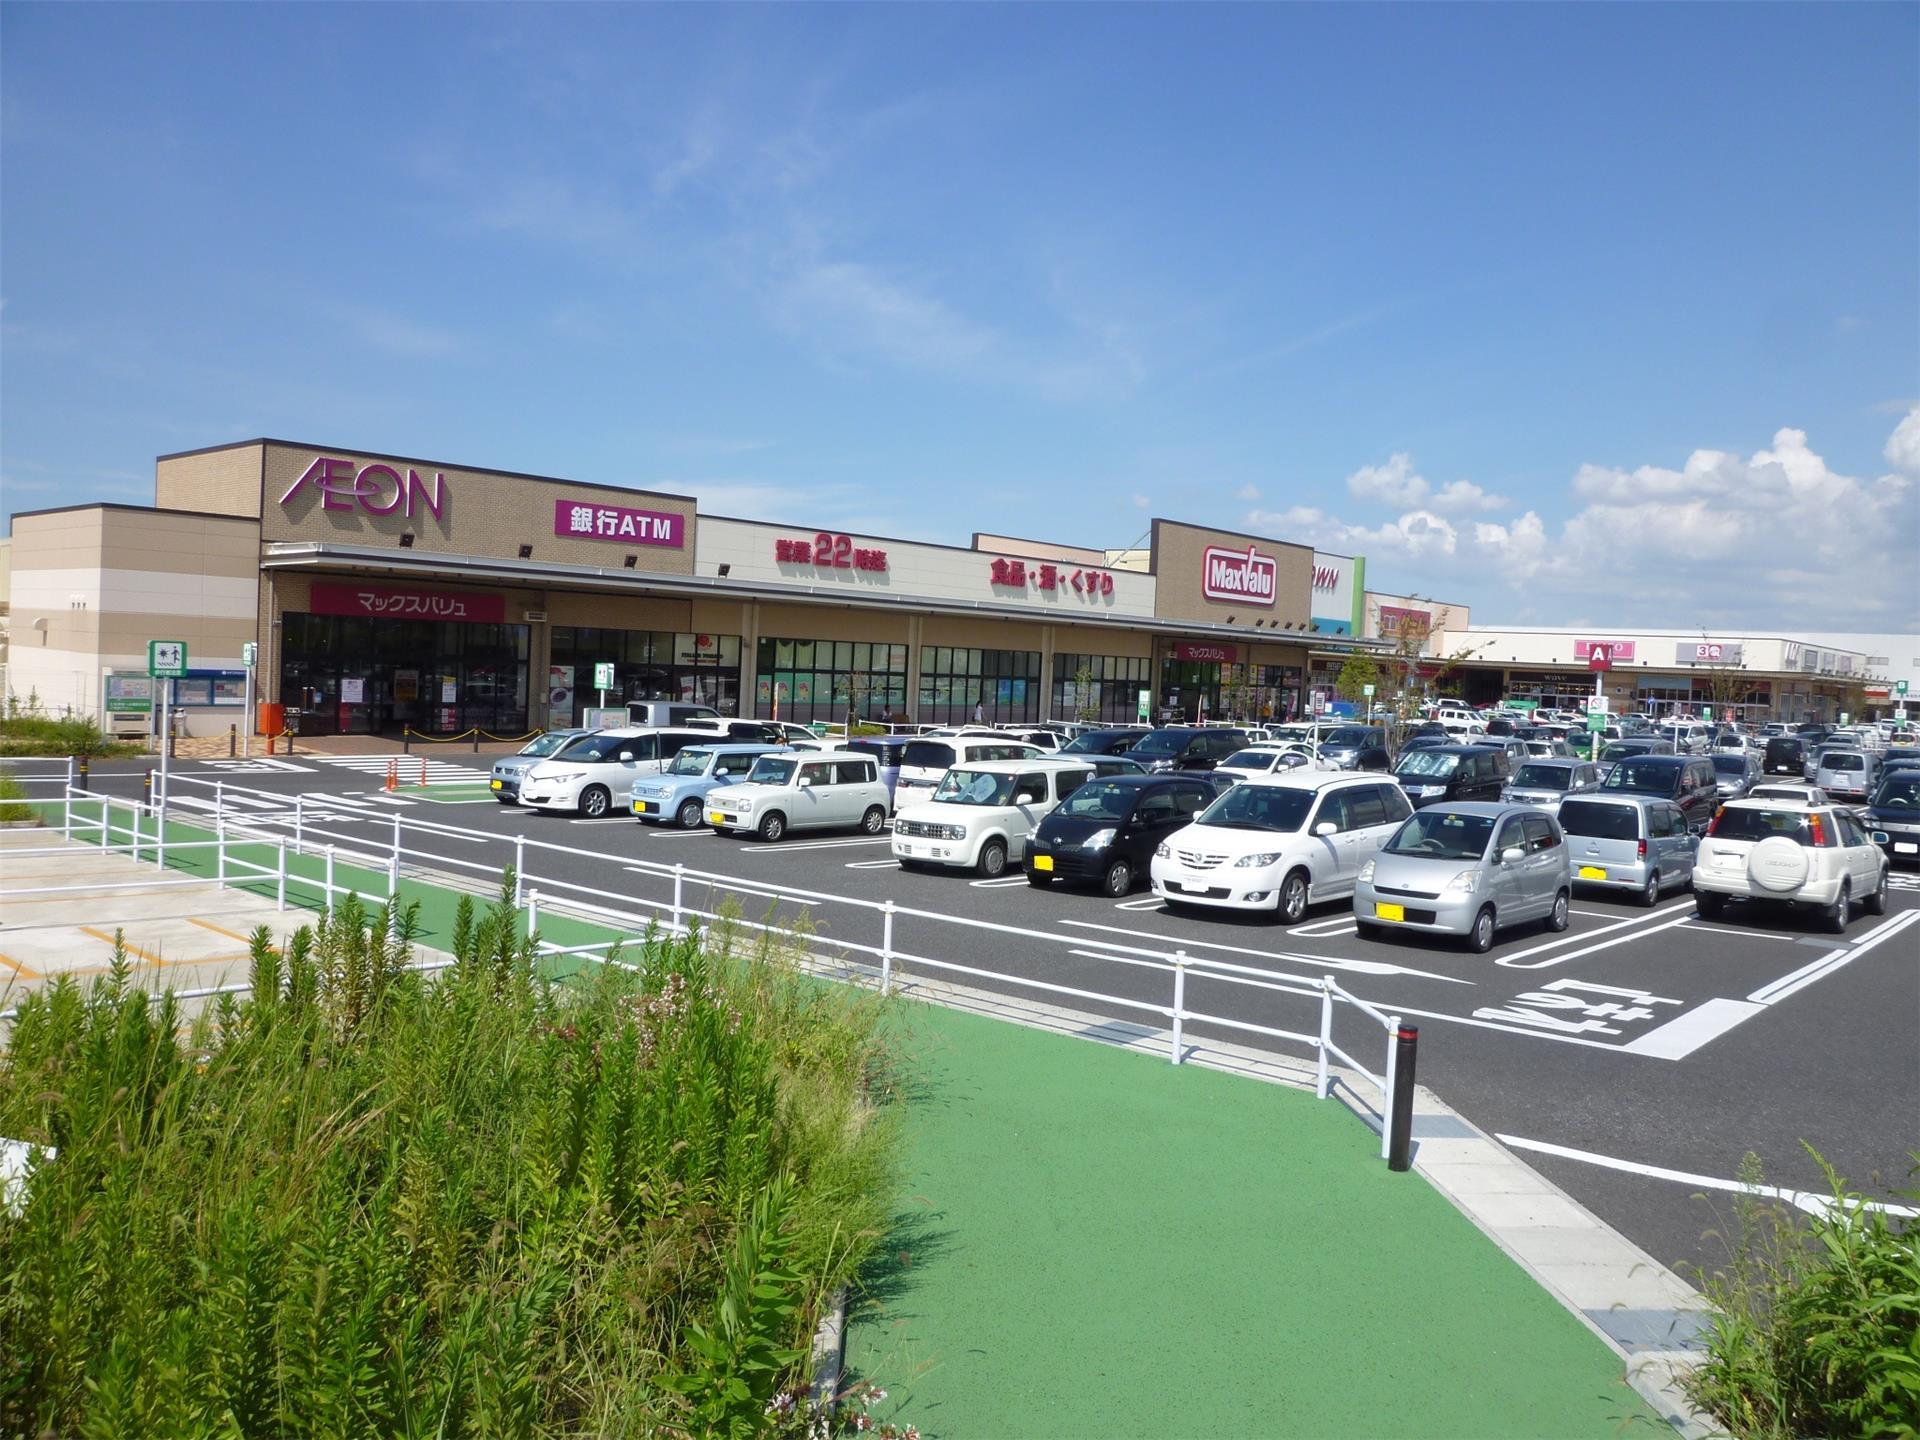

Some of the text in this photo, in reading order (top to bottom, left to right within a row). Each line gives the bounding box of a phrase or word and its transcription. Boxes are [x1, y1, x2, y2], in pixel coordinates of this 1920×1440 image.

[571, 506, 671, 540] 銀行ATM
[990, 558, 1114, 596] 食品・酒・くすり
[1211, 545, 1272, 595] MaxValu
[358, 592, 467, 617] マックスバリュ
[1188, 646, 1225, 660] マックスバリュ
[1591, 647, 1604, 661] A
